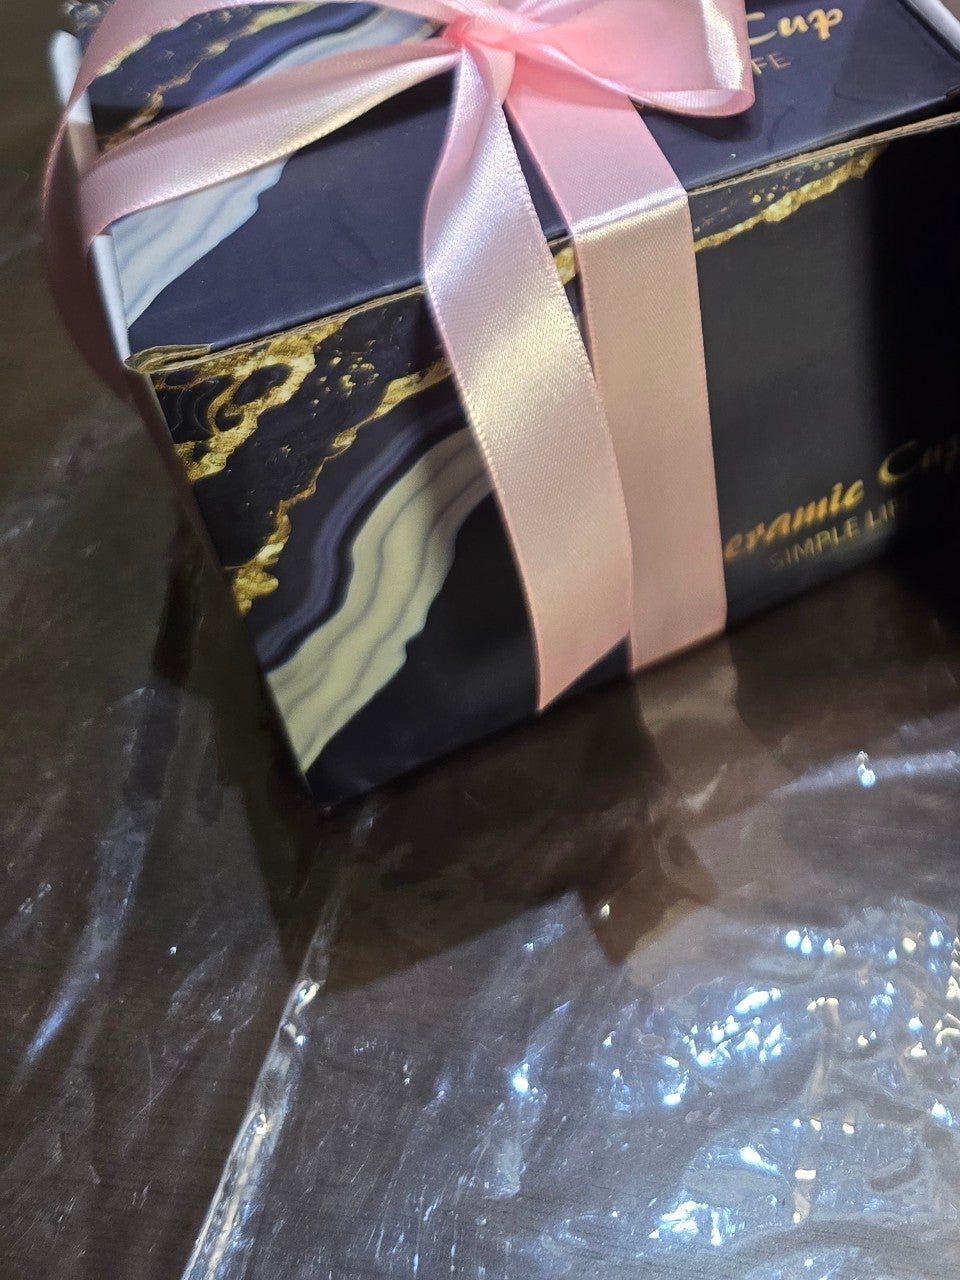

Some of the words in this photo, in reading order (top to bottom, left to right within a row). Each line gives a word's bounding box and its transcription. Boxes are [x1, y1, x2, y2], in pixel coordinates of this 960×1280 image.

[751, 51, 792, 76] FE
[723, 478, 865, 561] eramic
[768, 515, 861, 572] SIMPLE
